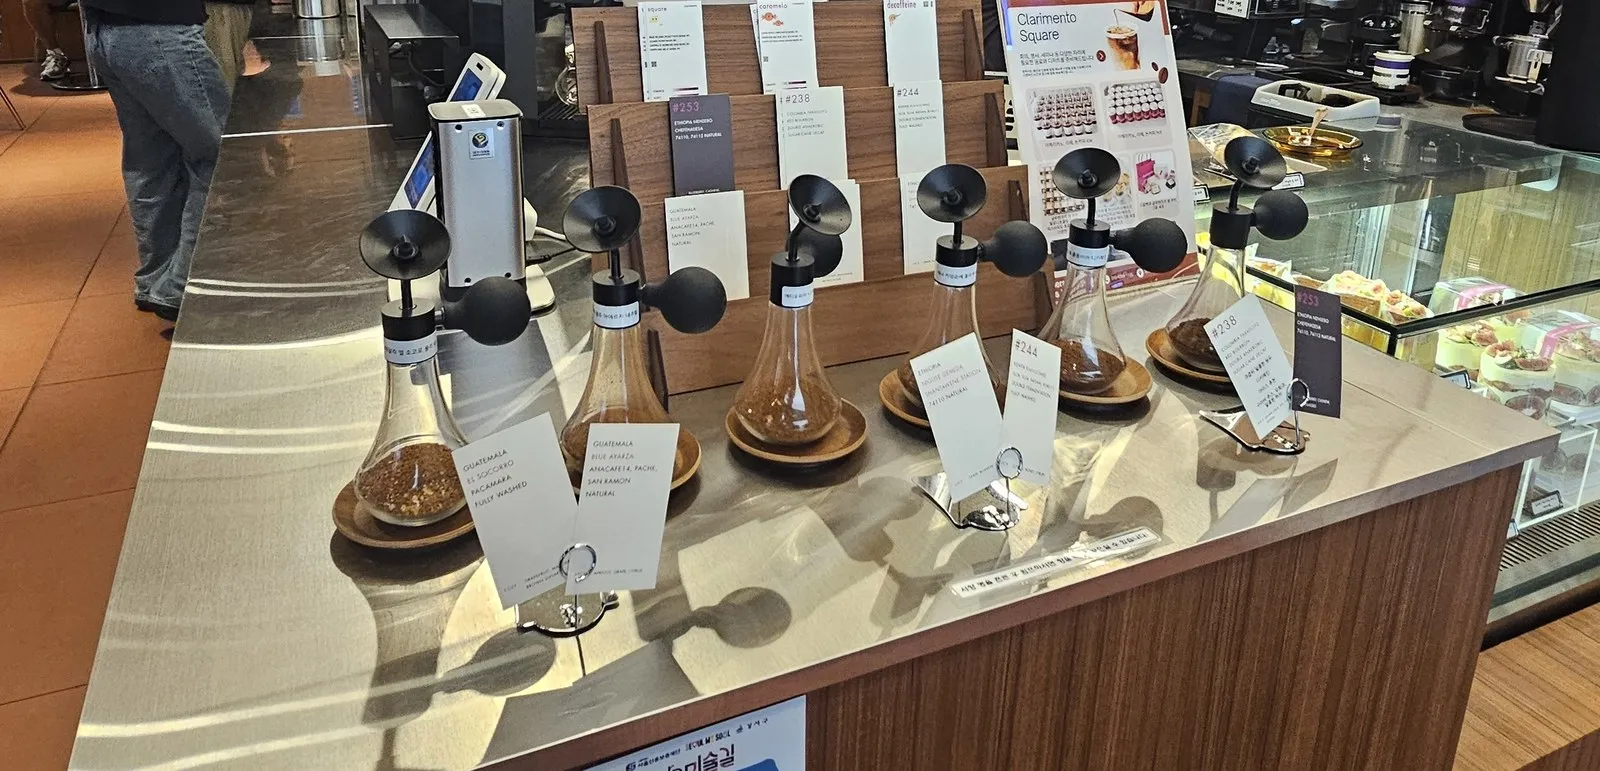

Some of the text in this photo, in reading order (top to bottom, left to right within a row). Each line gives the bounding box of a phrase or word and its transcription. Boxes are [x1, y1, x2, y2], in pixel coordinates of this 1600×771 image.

[759, 2, 788, 10] caramelo
[1017, 12, 1077, 26] Clarimento
[1020, 29, 1060, 44] Square
[786, 94, 810, 104] #238
[897, 88, 919, 97] #244
[672, 101, 700, 113] #253
[1296, 292, 1320, 307] #253
[1212, 315, 1237, 339] #238
[1014, 340, 1038, 358] #244
[918, 362, 942, 376] ETHIOPIA
[945, 386, 969, 400] NATURAL
[593, 440, 634, 448] GUATEMALA
[463, 449, 508, 472] GUATEMALA
[467, 459, 514, 486] EL SOCORRO
[471, 474, 512, 496] PACAMARA
[588, 477, 632, 486] SAN RAMON
[474, 480, 528, 508] FULLY WASHED
[585, 490, 616, 498] NATURAL
